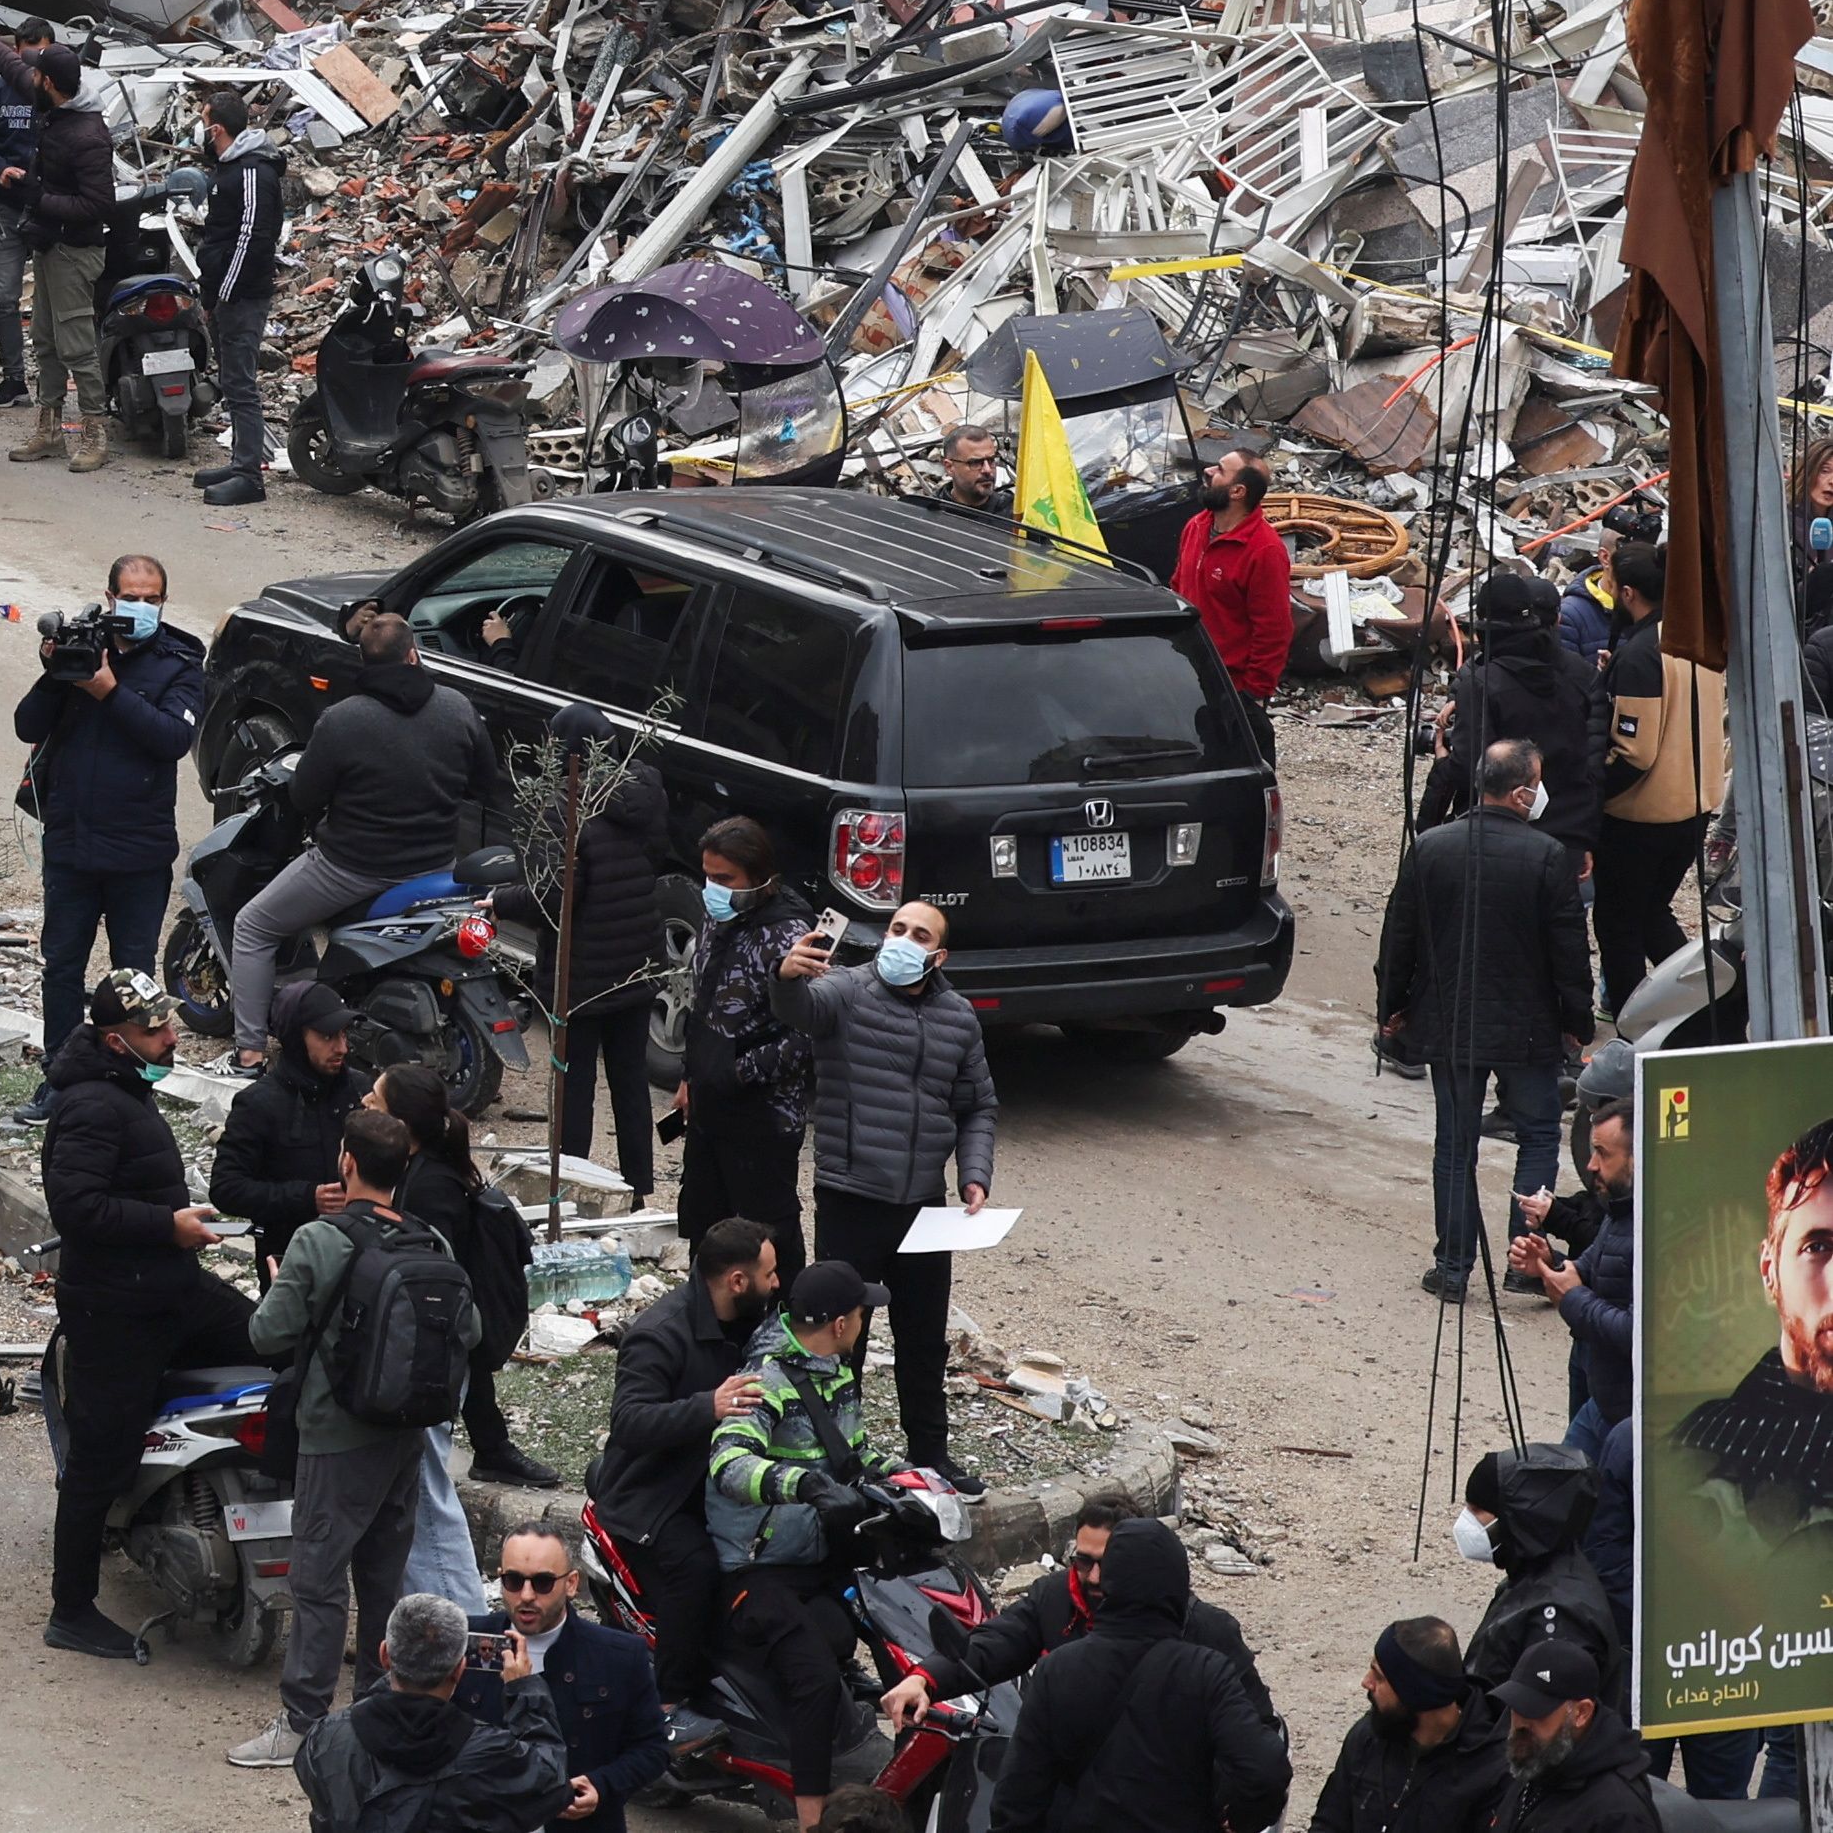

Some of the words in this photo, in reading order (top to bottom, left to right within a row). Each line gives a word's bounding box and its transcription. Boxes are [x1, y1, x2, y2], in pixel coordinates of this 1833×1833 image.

[1064, 842, 1071, 853] N
[1073, 836, 1124, 854] 108834
[1666, 1624, 1764, 1679] كوراني
[1769, 1627, 1833, 1669] سين
